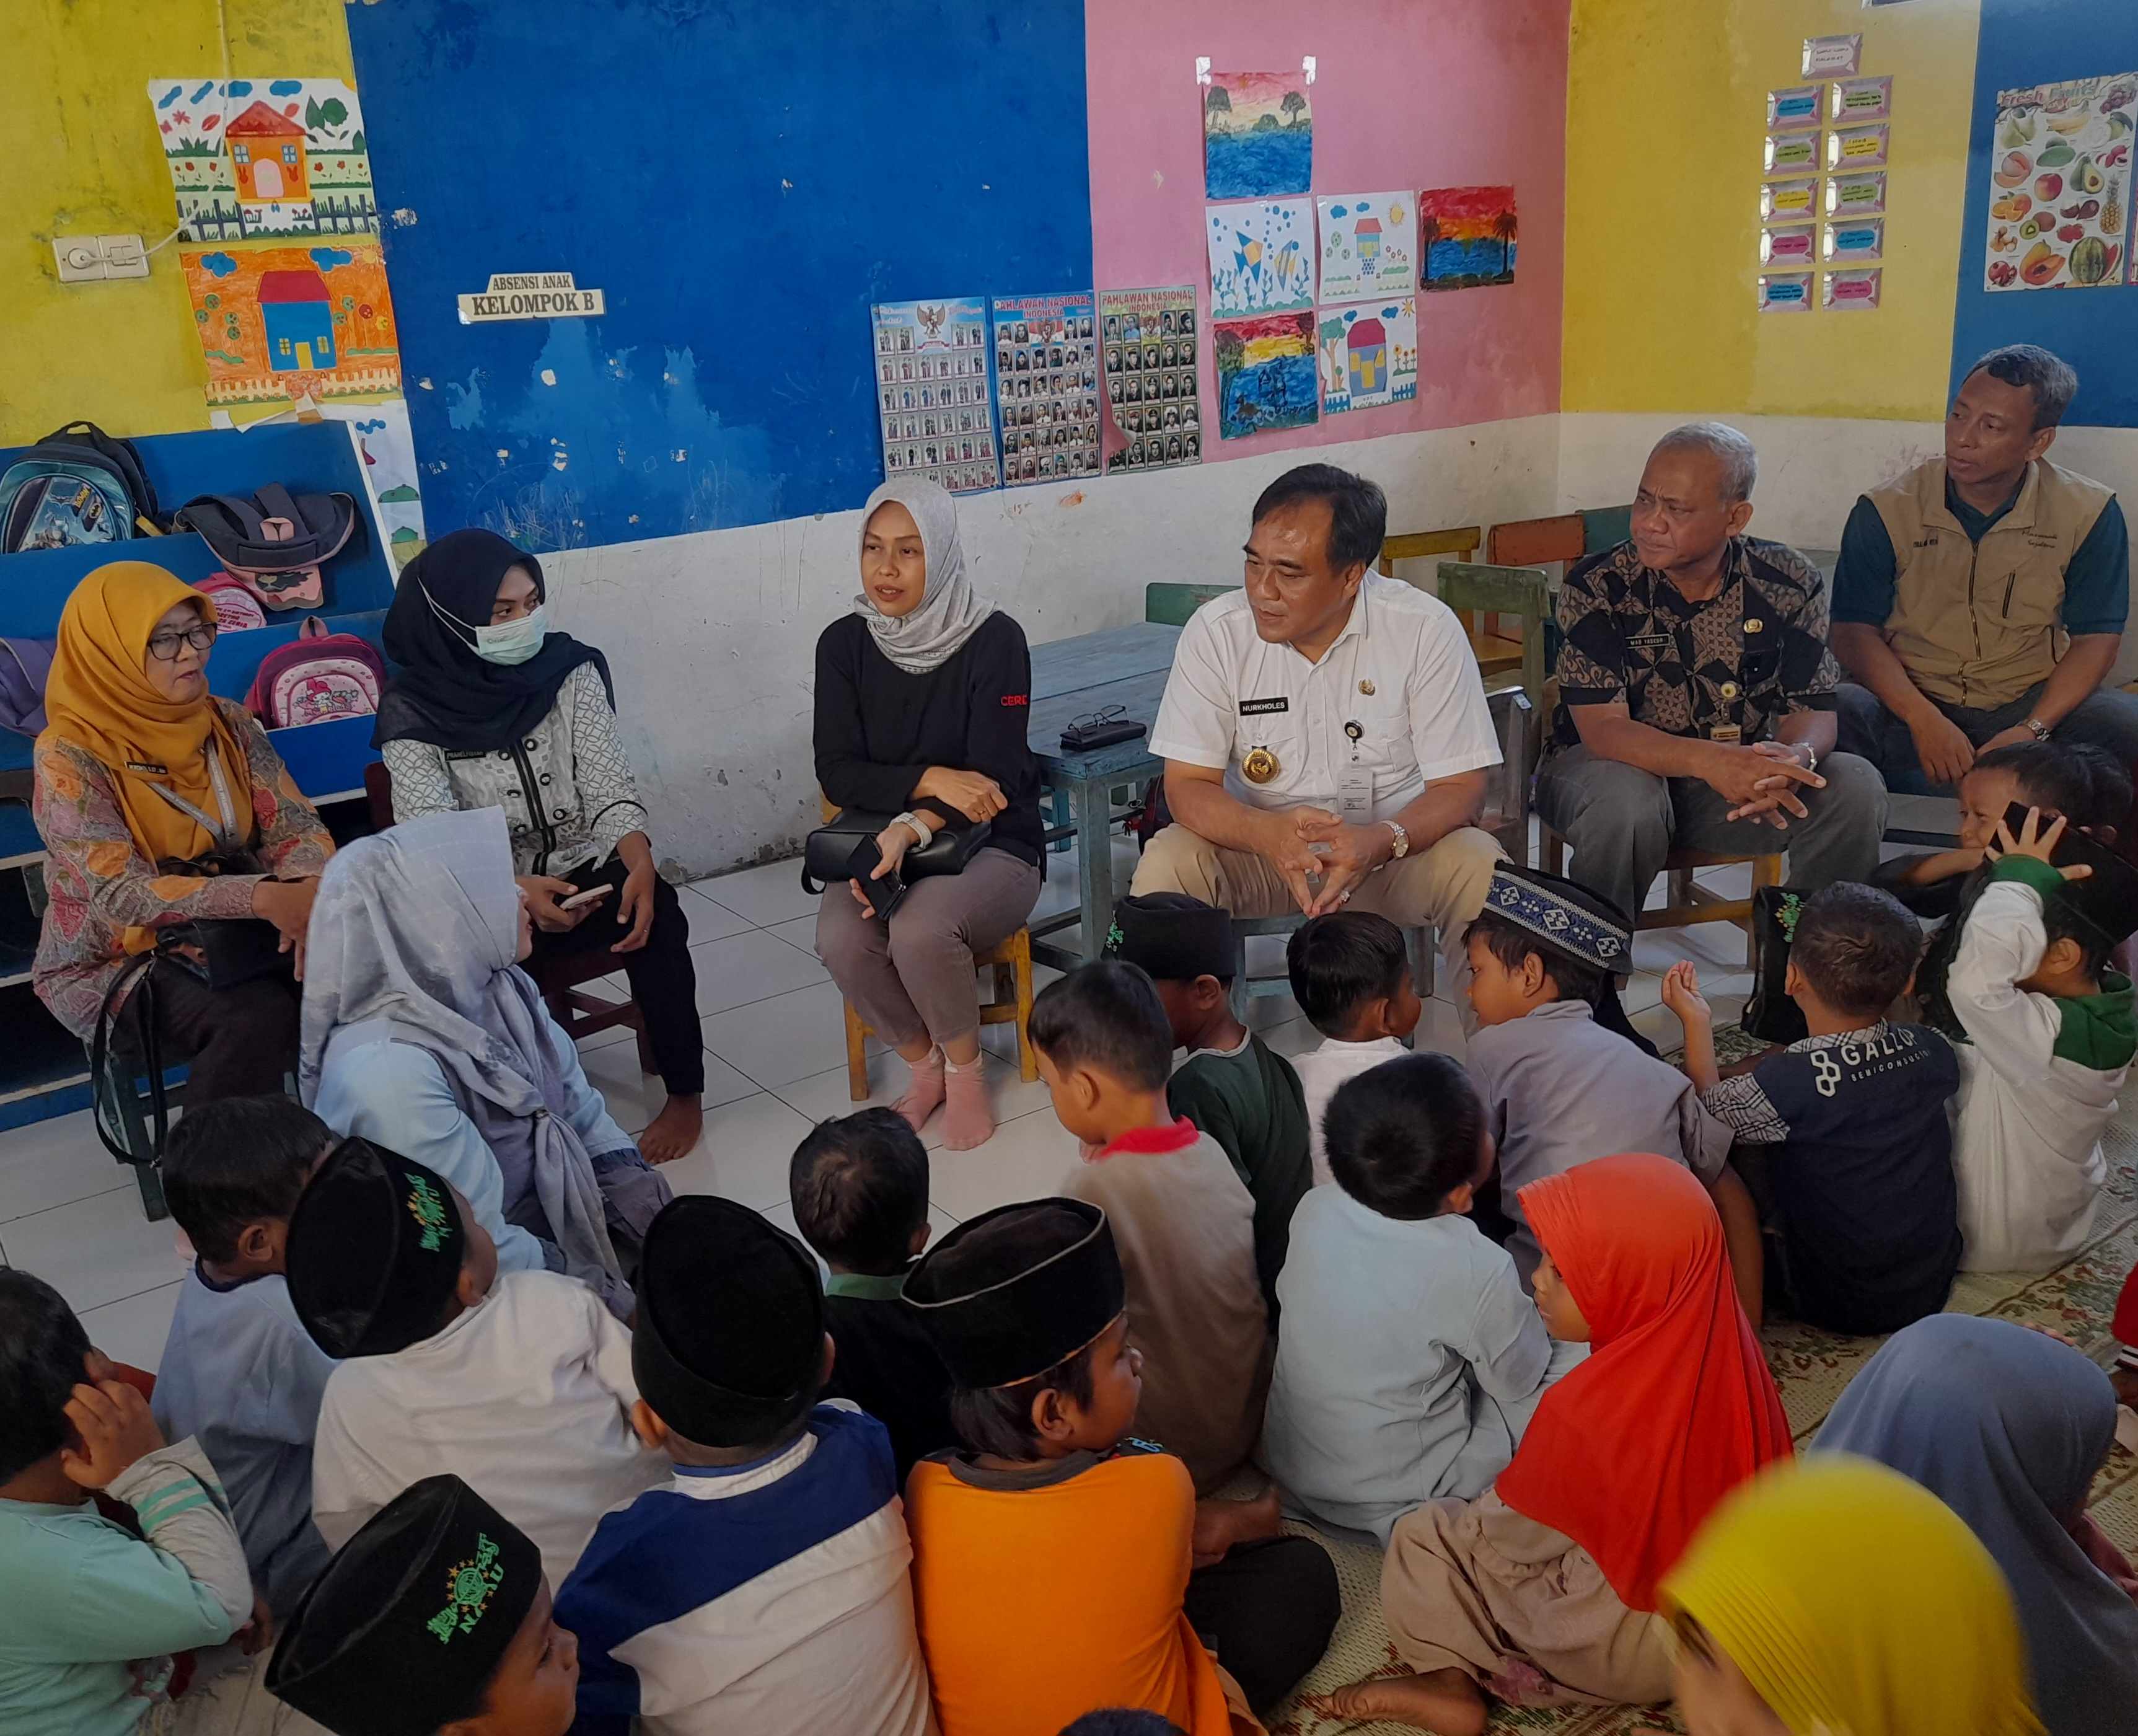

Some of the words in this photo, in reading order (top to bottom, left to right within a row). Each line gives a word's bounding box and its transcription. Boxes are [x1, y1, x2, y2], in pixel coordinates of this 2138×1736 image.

[2001, 90, 2044, 105] Fresh
[493, 276, 539, 291] ABSENSI
[542, 275, 571, 288] ANAK
[1047, 294, 1091, 308] NASIONAL
[1151, 289, 1192, 302] NASIONAL
[472, 293, 579, 315] KELOMPOK
[583, 293, 594, 311] B
[1129, 304, 1167, 312] INDONESIA
[1024, 308, 1065, 318] INDONESIA
[1243, 702, 1285, 712] NURKHOLES
